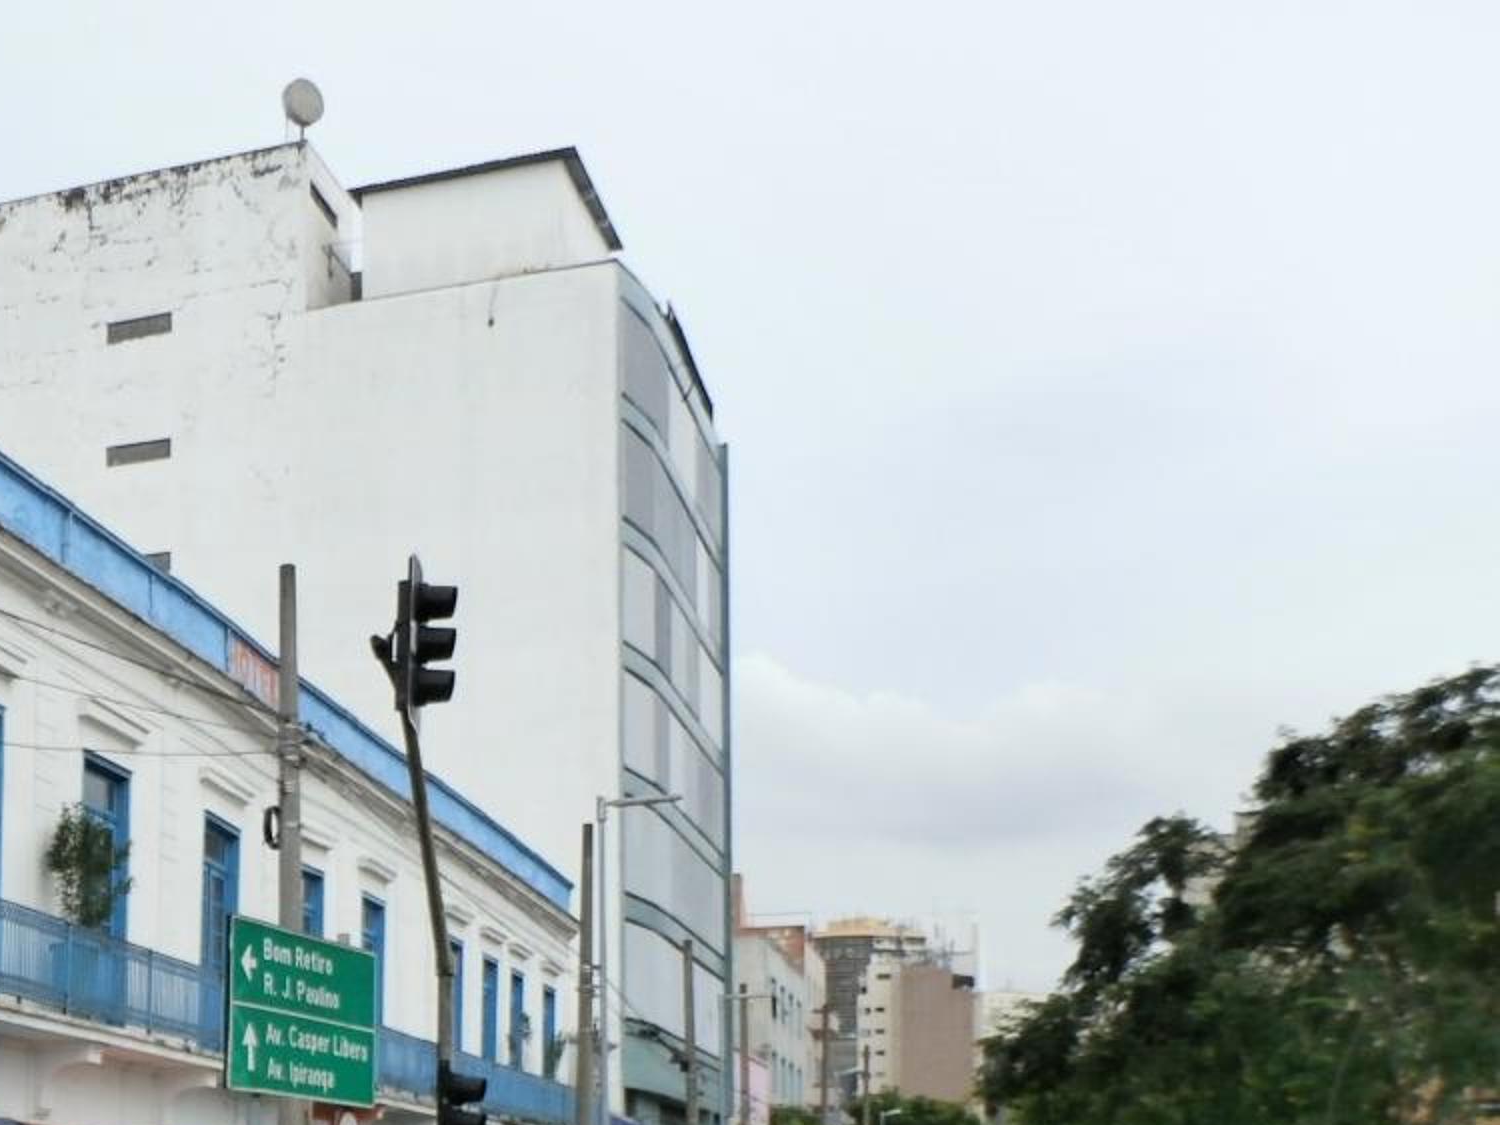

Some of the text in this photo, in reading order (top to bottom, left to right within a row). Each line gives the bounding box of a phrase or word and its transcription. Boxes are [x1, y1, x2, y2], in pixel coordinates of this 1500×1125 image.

[263, 938, 333, 975] Bom Retiro
[263, 972, 278, 996] R.
[297, 981, 339, 1009] Paulino
[265, 1022, 285, 1046] Av.
[289, 1059, 334, 1095] Ipiranga
